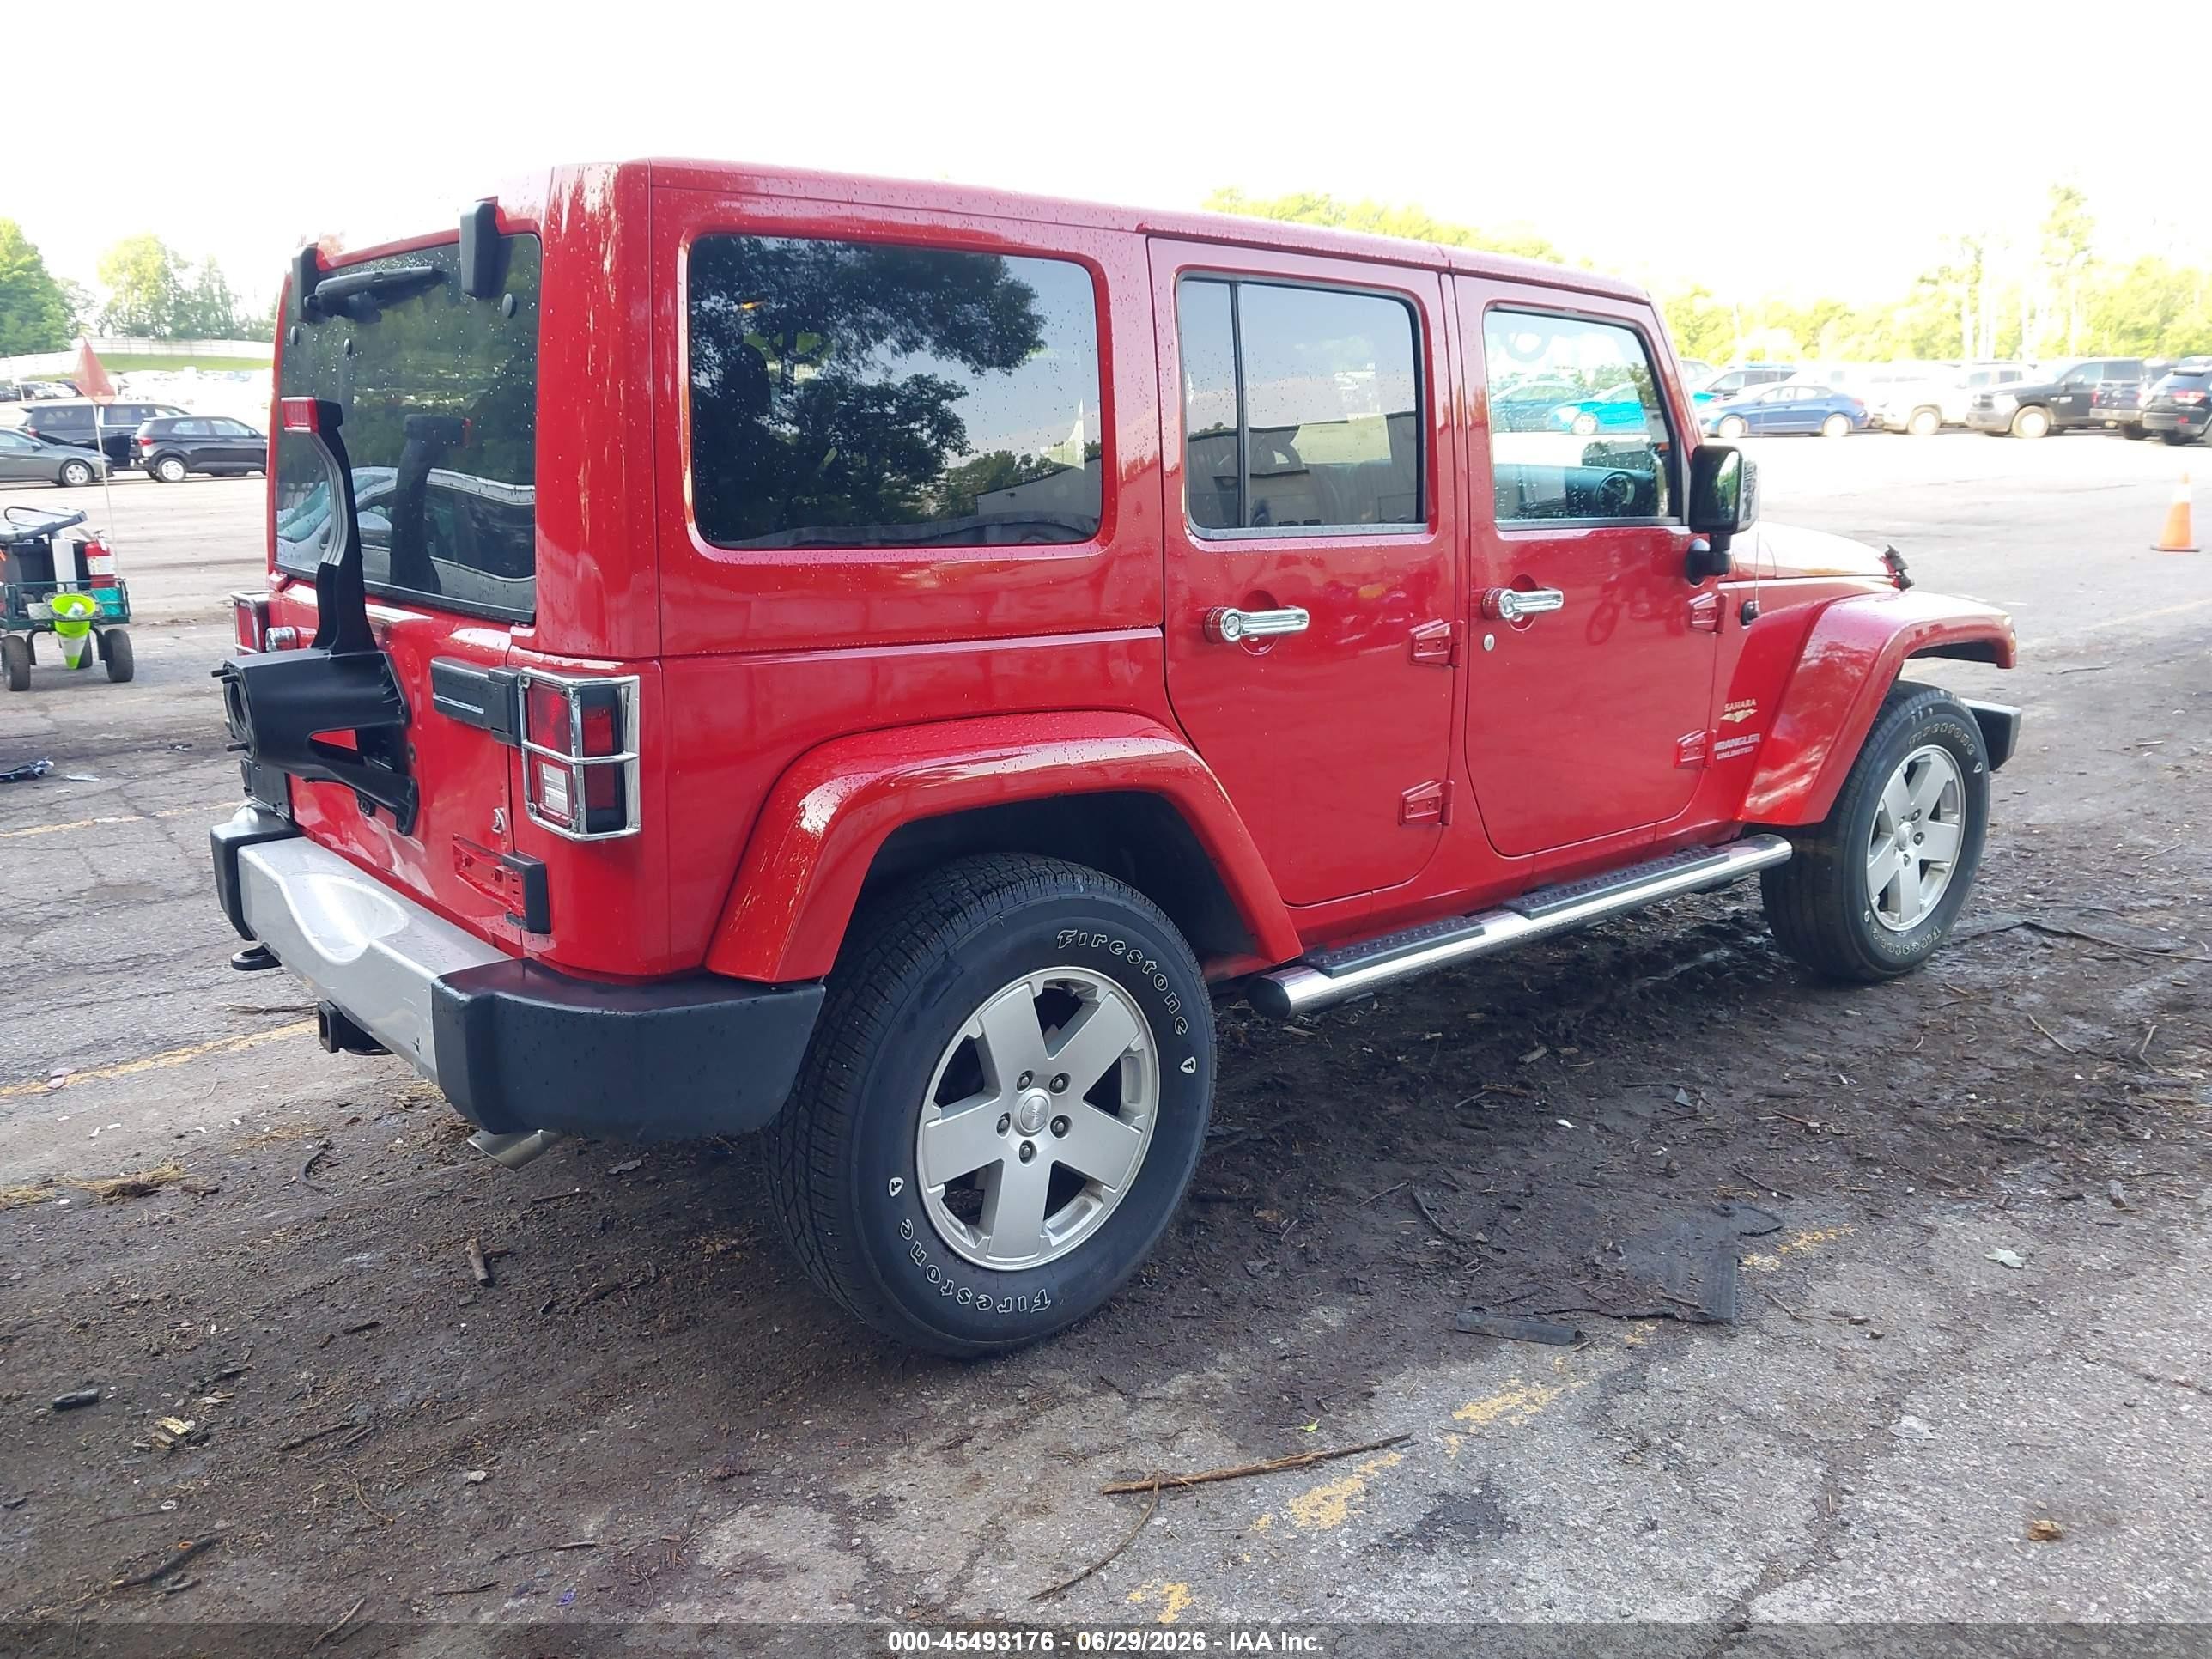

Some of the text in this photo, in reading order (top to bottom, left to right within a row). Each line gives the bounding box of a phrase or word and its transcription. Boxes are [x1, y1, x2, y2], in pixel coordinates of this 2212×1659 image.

[1723, 698, 1757, 712] SAHARA
[1056, 929, 1188, 1036] Firestone
[900, 1218, 1052, 1314] Firestone
